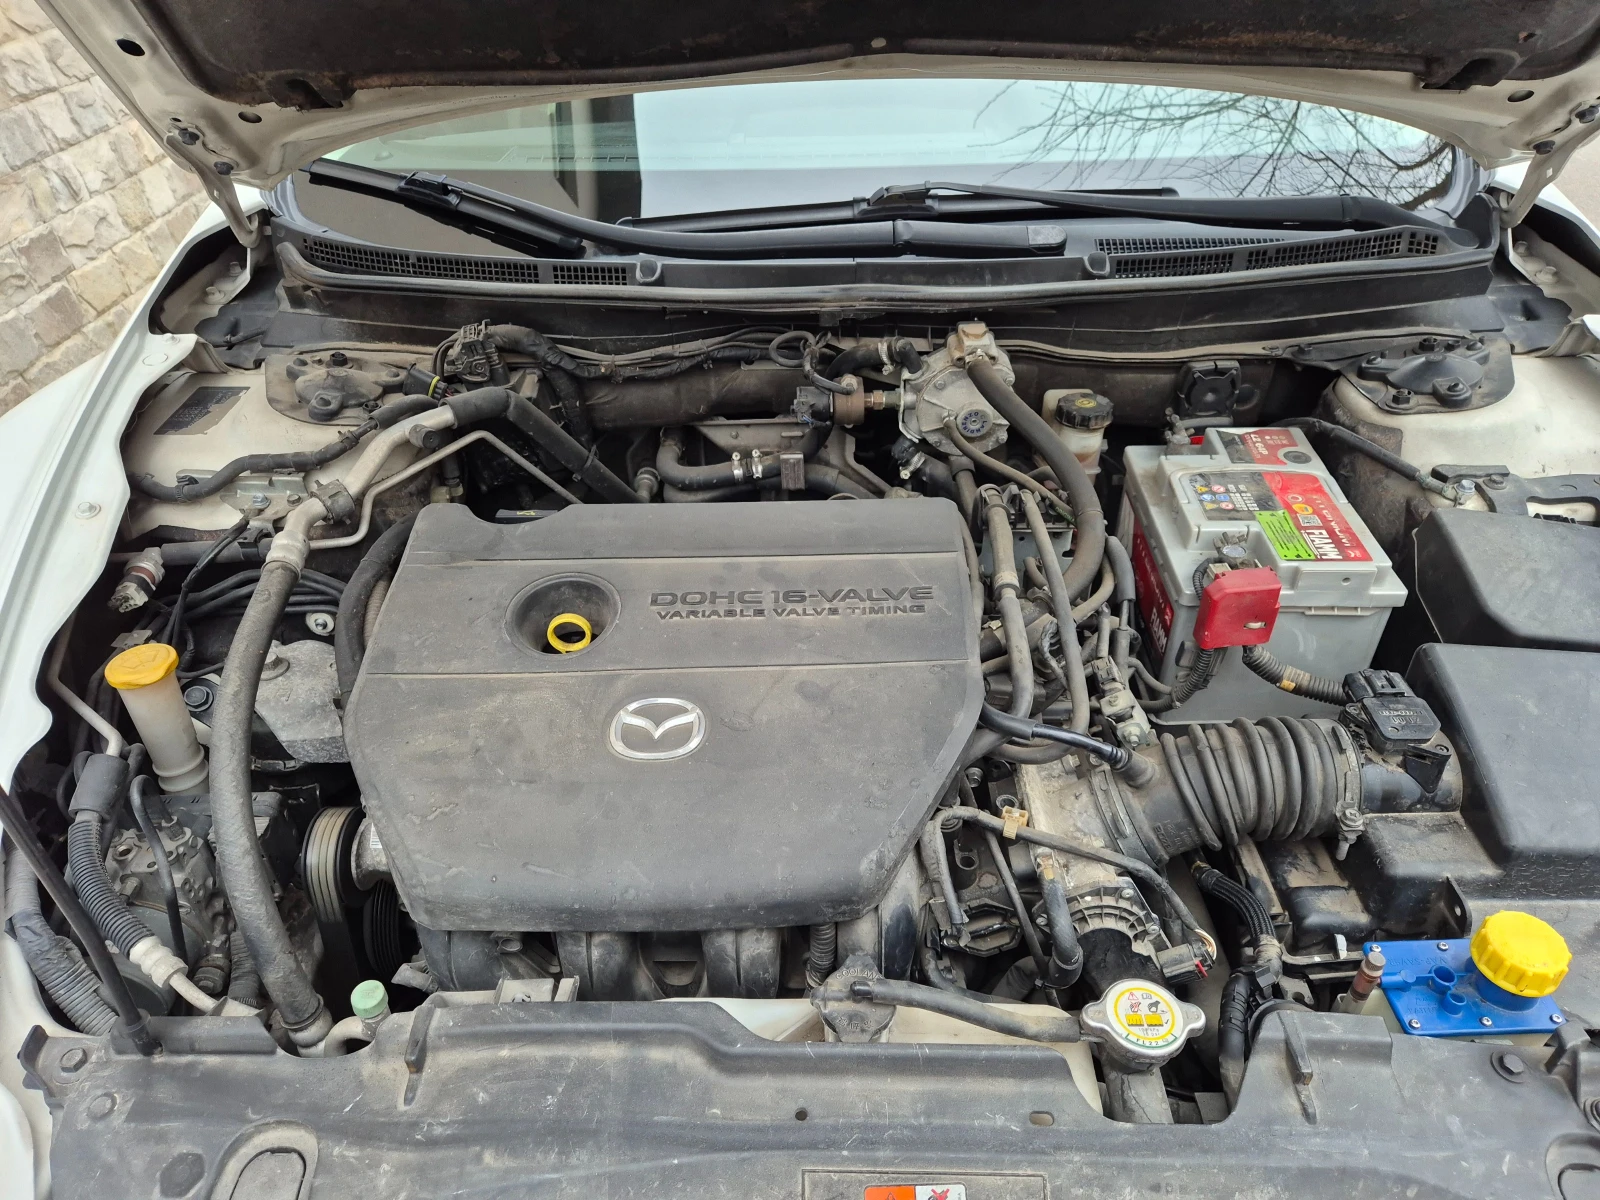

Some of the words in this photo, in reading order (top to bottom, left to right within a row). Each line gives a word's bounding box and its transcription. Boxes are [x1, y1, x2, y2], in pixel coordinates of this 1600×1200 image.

[1305, 529, 1343, 559] FIAMM
[650, 590, 763, 606] DOHC
[770, 585, 934, 604] 16-VALVE
[657, 608, 767, 620] VARIABLE
[773, 606, 839, 618] VALVE
[844, 603, 926, 616] TIMING
[1150, 606, 1168, 653] FIAMM
[1136, 1037, 1160, 1046] FL22
